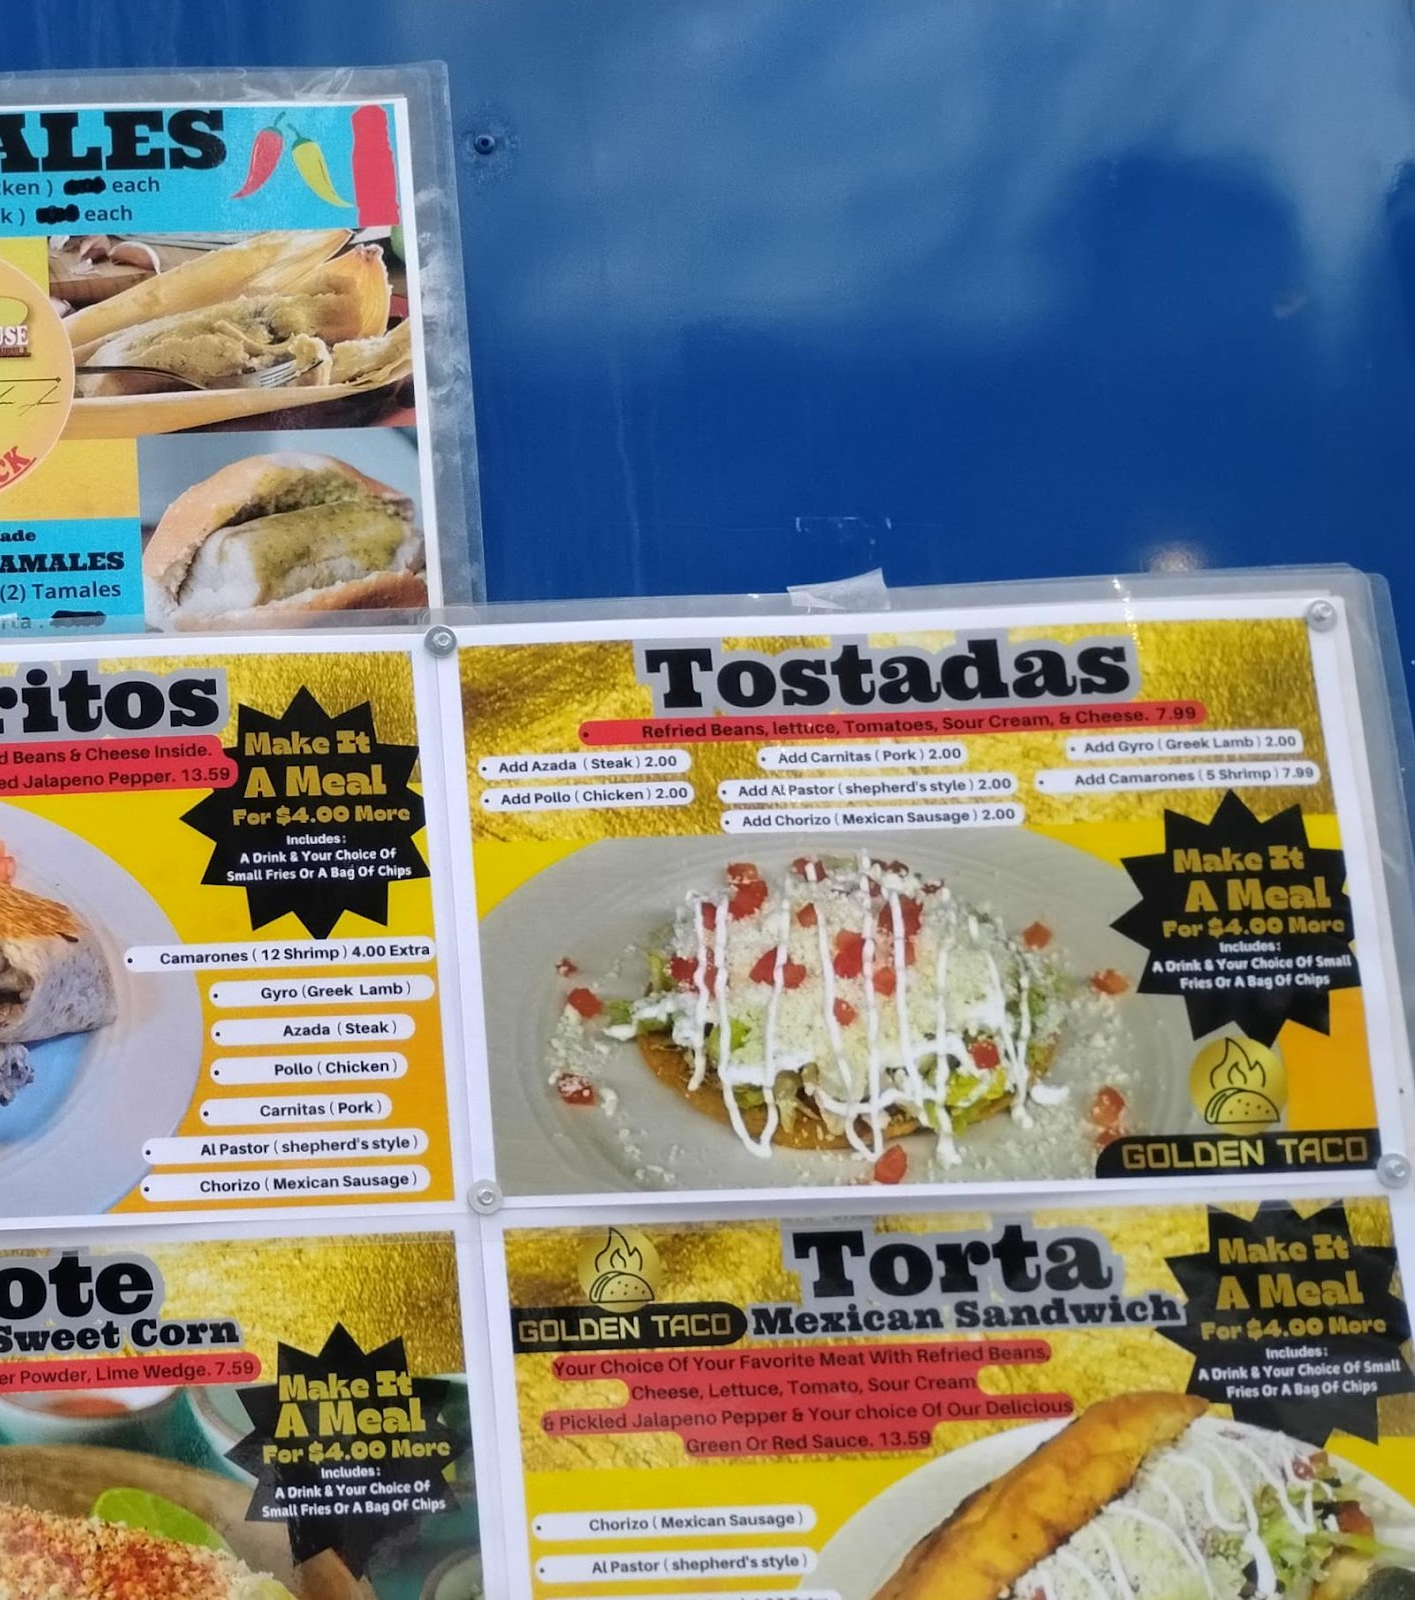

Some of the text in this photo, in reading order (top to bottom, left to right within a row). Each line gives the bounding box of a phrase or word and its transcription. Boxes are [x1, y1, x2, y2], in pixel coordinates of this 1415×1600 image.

[111, 175, 160, 194] each
[83, 204, 133, 223] each
[0, 583, 26, 605] (2)
[30, 580, 121, 601] Tamales
[645, 639, 1131, 708] Tostadas
[641, 706, 1197, 739] Refried Beans, lettuce, Tomatoes, Sour Cream, & Cheese. 7.99
[11, 750, 66, 766] Beans
[68, 747, 82, 763] &
[84, 746, 151, 762] Cheese
[153, 742, 212, 759] Inside.
[21, 773, 105, 791] Jalapeno
[107, 770, 176, 789] Pepper.
[180, 766, 231, 783] 13.59
[285, 832, 346, 846] Includes:
[239, 846, 396, 865] A Drink & Your Choice Of
[226, 863, 412, 883] Small Fries Or A Bag Of Chips
[159, 951, 249, 966] Camarones
[260, 947, 280, 961] 12
[283, 946, 340, 962] Shrimp
[351, 944, 386, 958] 4.00
[389, 943, 430, 957] Extra
[1121, 1136, 1367, 1170] GOLDEN TACO
[792, 1223, 1114, 1299] Torta
[750, 1293, 1181, 1336] Mexican Sandwich
[130, 1318, 239, 1348] Corn
[19, 1367, 91, 1385] Powder,
[95, 1365, 140, 1382] Lime
[142, 1362, 211, 1386] Wedge.
[214, 1359, 254, 1376] 7.59
[685, 1429, 932, 1457] Green Or Red Sauce. 13.59
[588, 1516, 649, 1533] Chorizo
[660, 1514, 726, 1530] Mexican
[728, 1513, 795, 1529] Sausage
